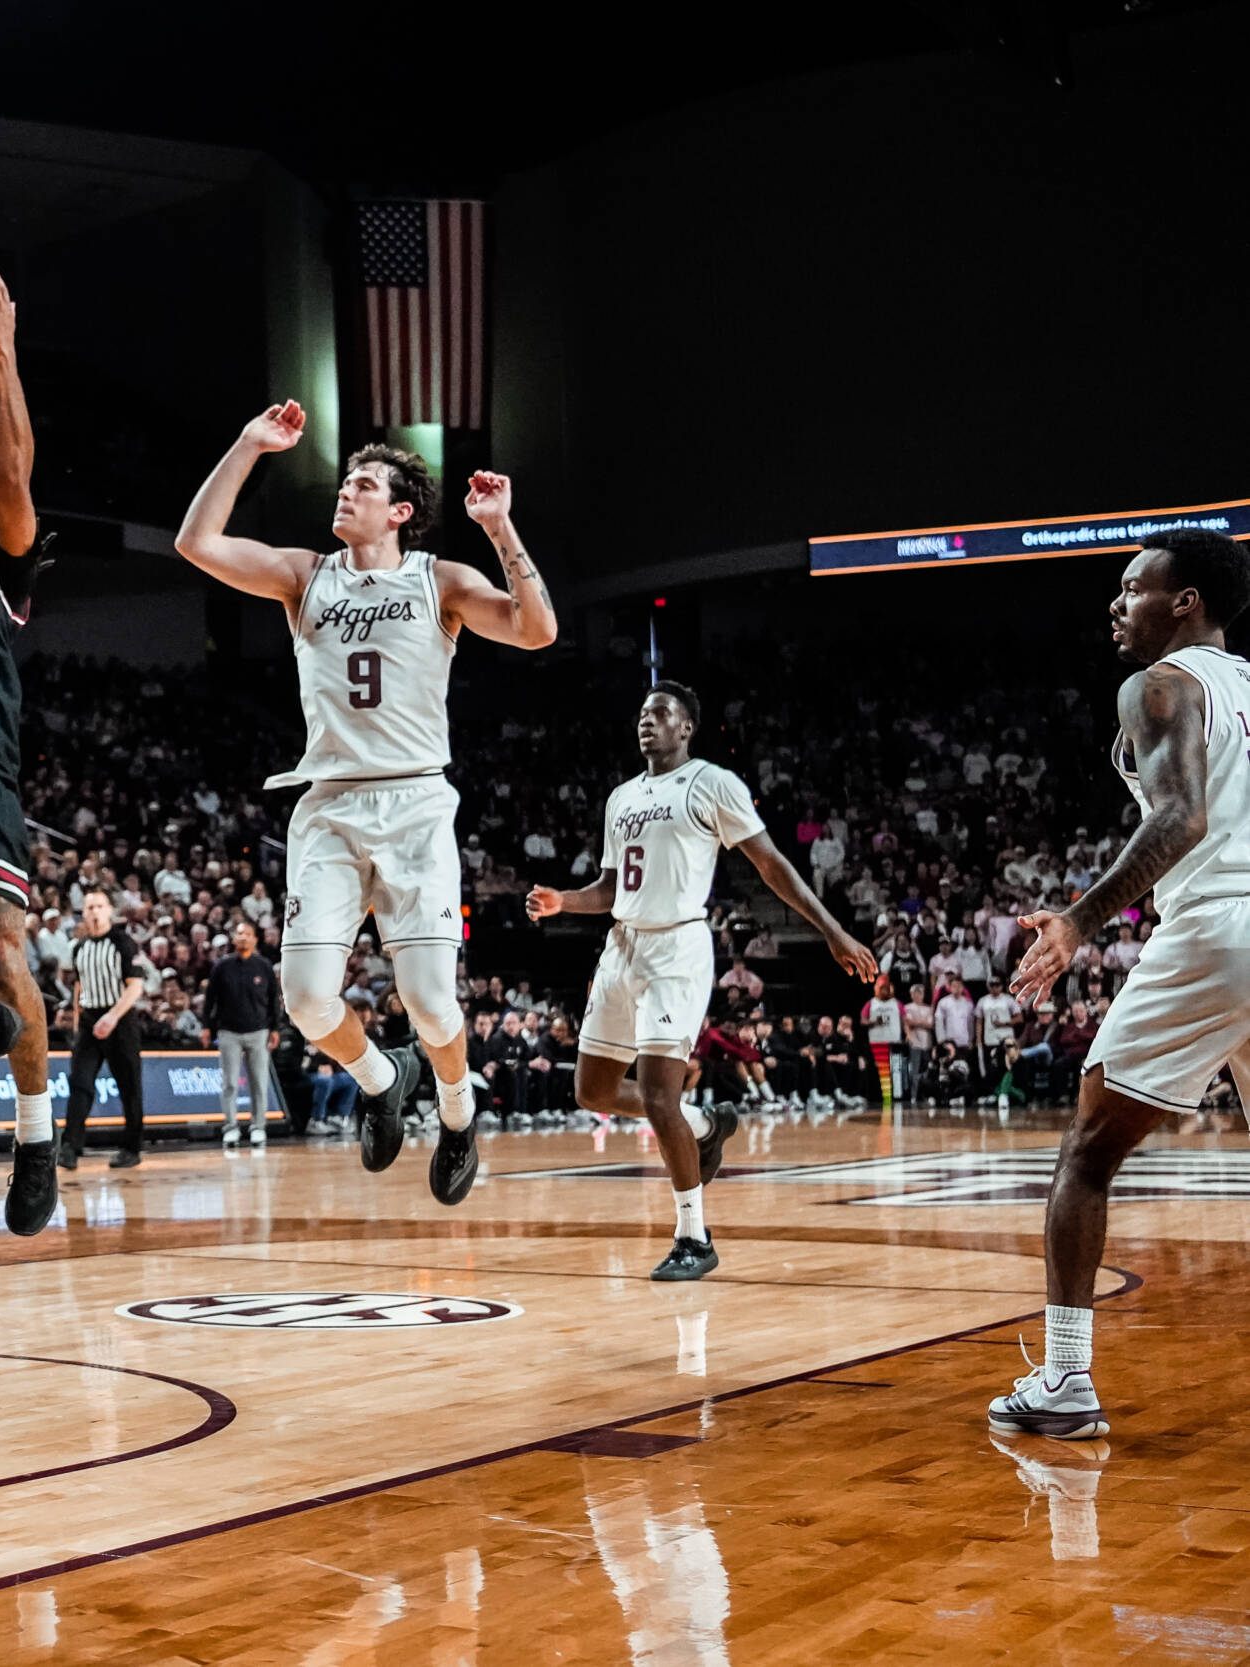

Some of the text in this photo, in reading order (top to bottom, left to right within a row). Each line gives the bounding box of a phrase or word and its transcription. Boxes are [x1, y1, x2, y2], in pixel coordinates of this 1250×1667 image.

[1022, 526, 1097, 547] Orthopedic
[1097, 527, 1127, 541] care
[315, 597, 417, 644] Aggies
[347, 650, 382, 710] 9
[613, 802, 674, 842] Aggies
[623, 845, 645, 892] 6
